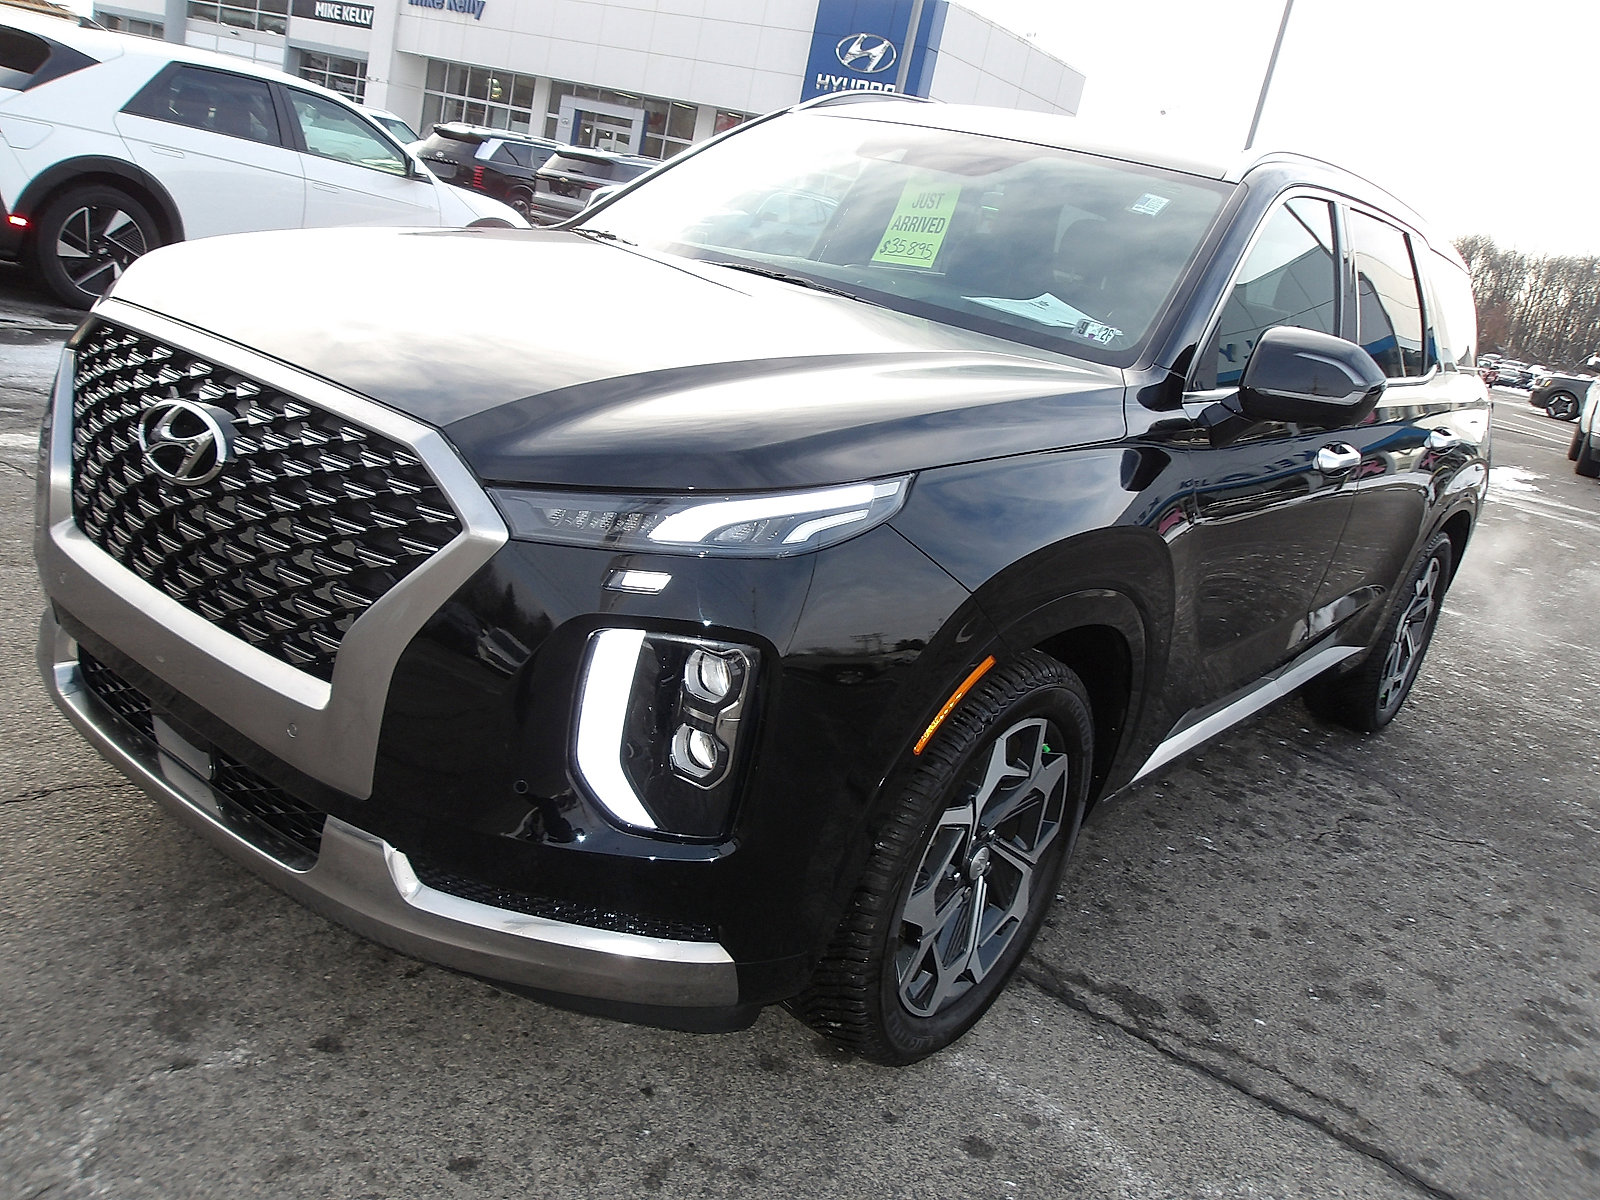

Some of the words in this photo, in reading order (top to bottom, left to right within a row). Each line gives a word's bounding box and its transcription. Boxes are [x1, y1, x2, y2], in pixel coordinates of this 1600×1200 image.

[314, 1, 341, 20] MIKE
[341, 5, 373, 25] KELLY
[815, 73, 897, 93] HYUNDA
[911, 192, 945, 209] JUST
[891, 215, 946, 234] ARRIVED
